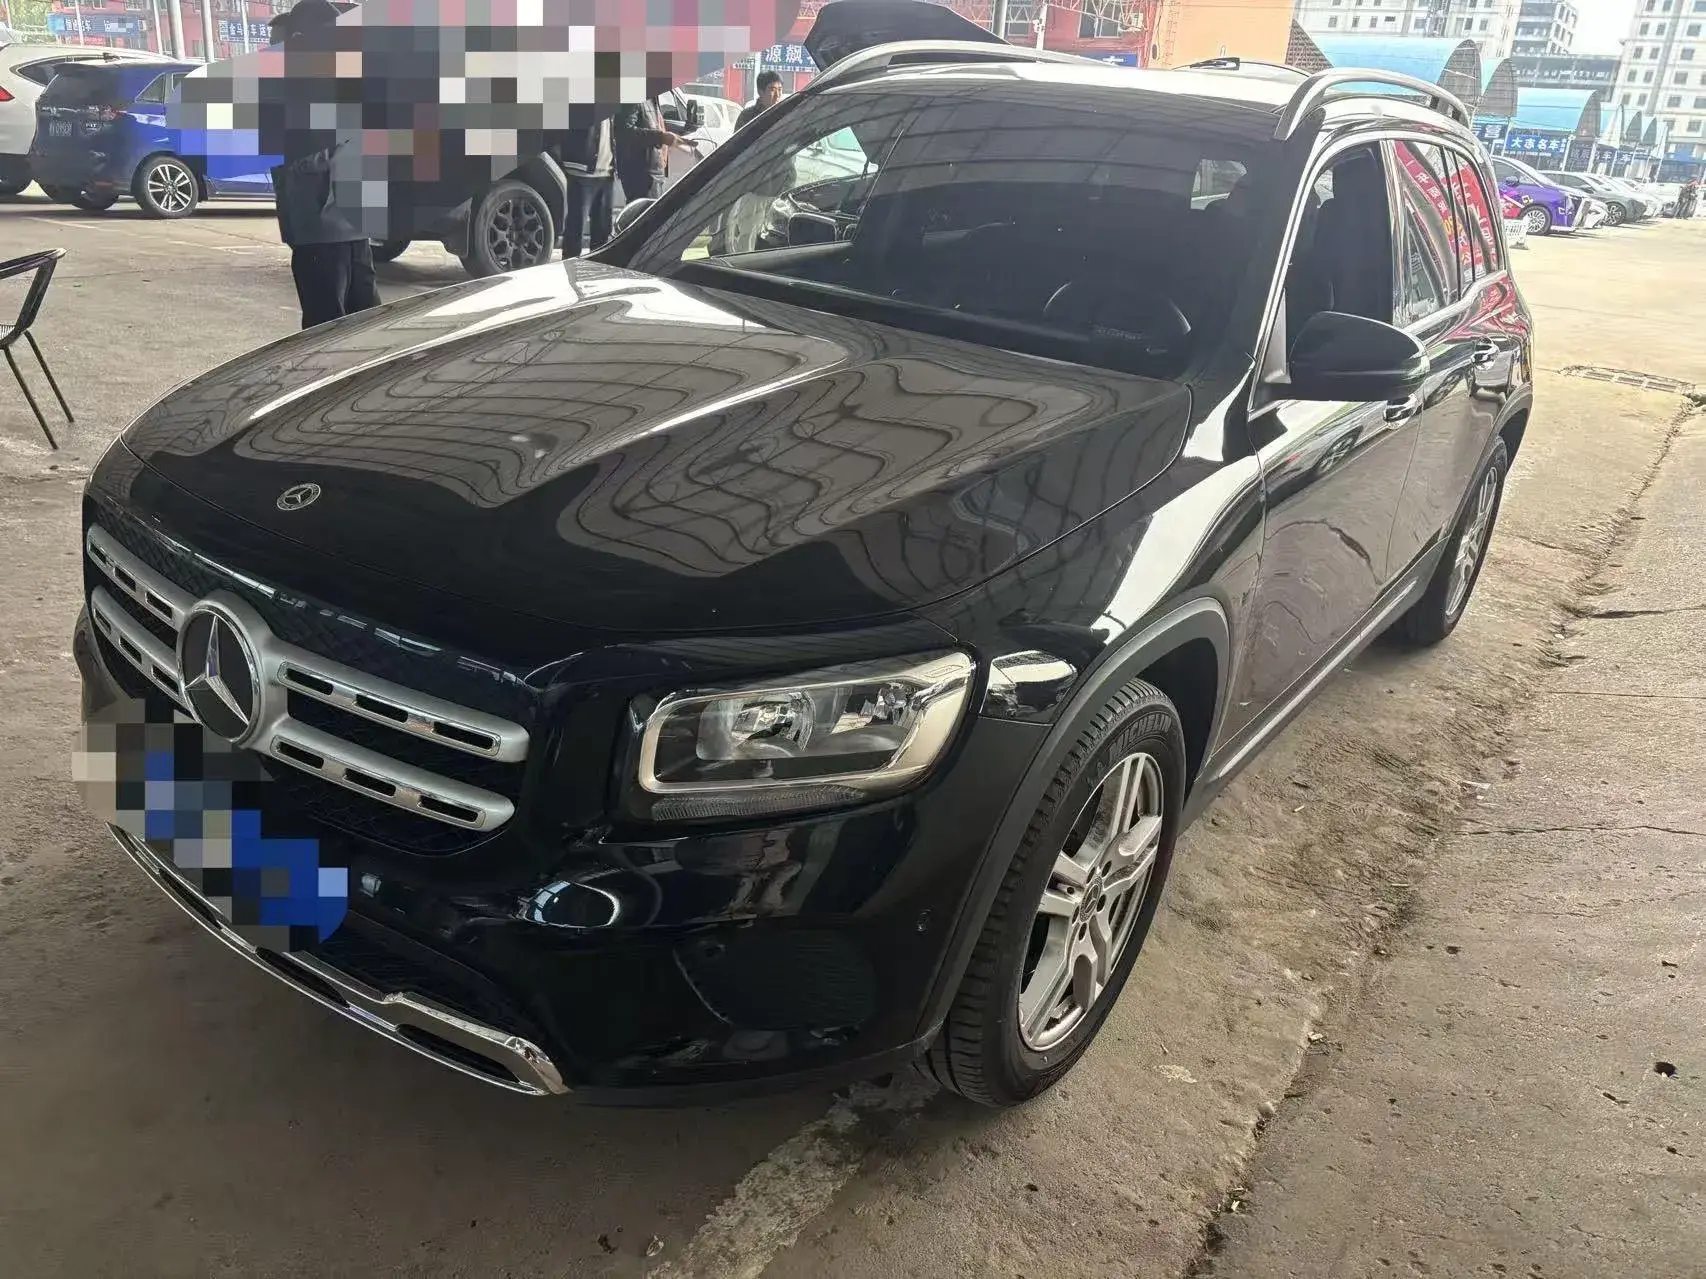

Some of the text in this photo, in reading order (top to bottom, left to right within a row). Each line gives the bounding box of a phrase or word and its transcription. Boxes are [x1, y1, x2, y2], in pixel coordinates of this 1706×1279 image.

[1510, 136, 1560, 151] 大志名车
[1109, 713, 1172, 758] MICHELIN
